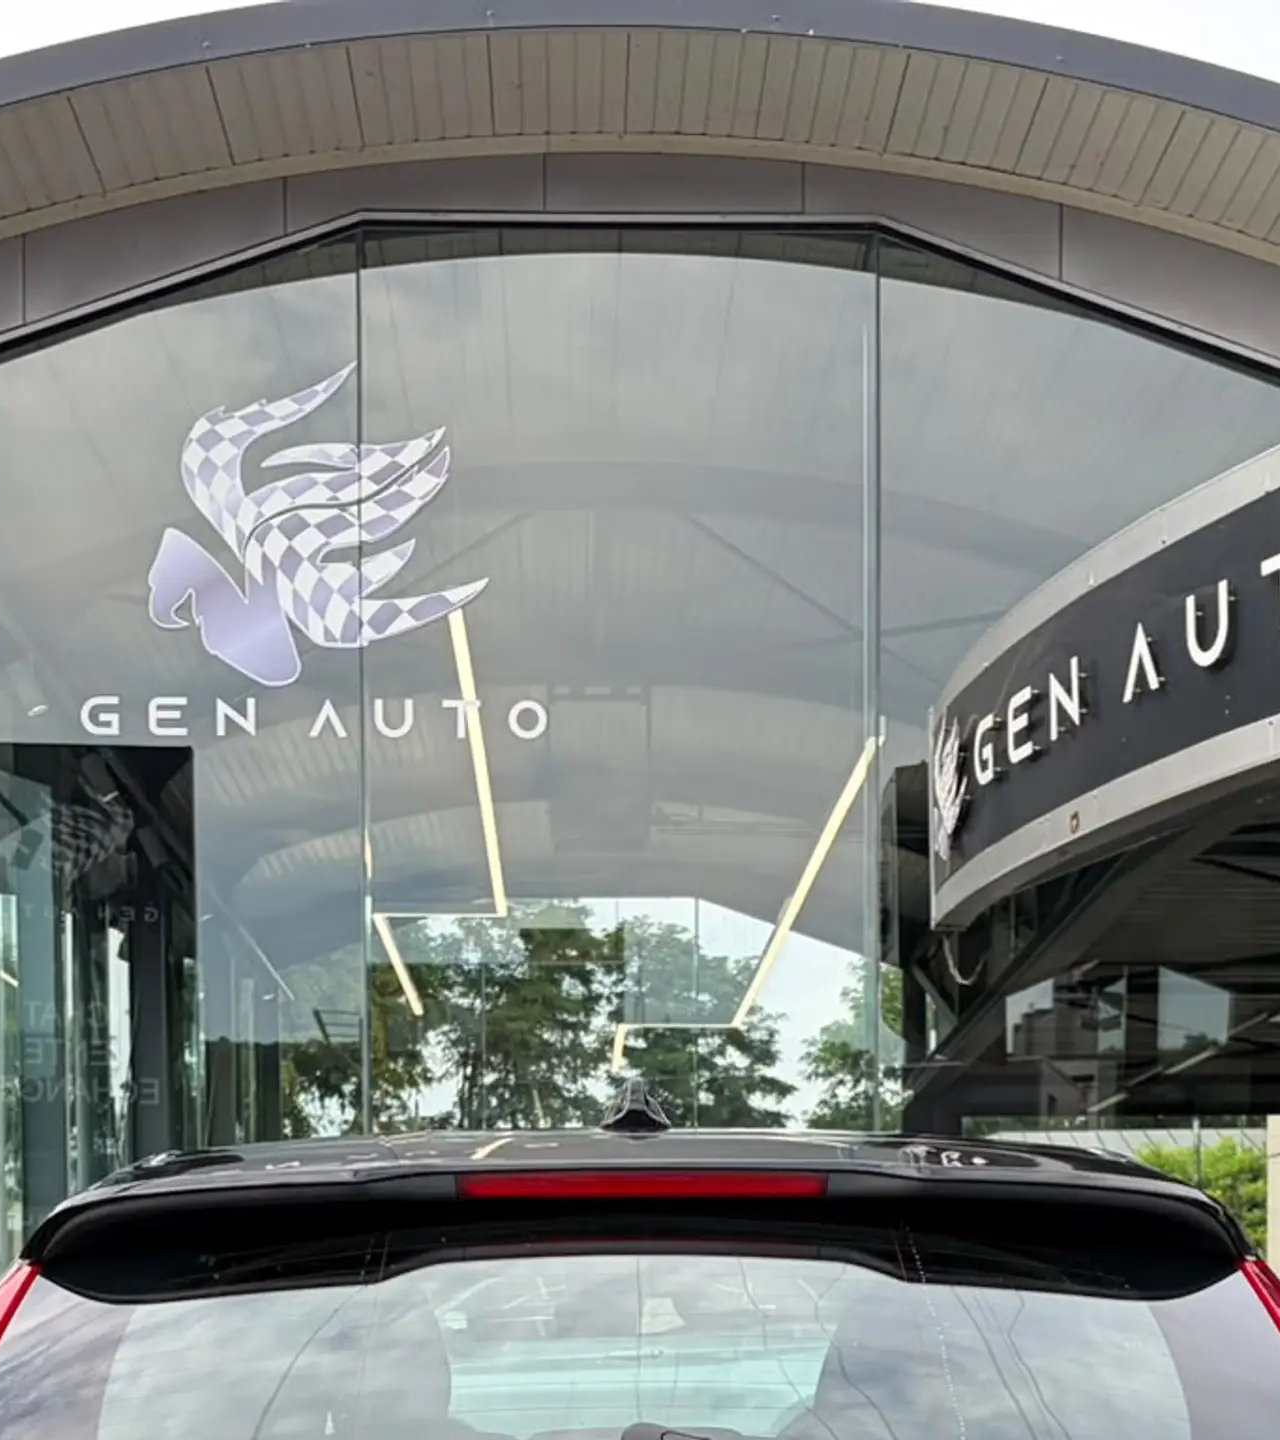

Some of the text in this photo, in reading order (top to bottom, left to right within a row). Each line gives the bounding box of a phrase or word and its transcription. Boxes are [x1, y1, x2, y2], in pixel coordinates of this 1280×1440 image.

[79, 694, 549, 739] GEN AUTO
[972, 654, 1081, 786] GEN
